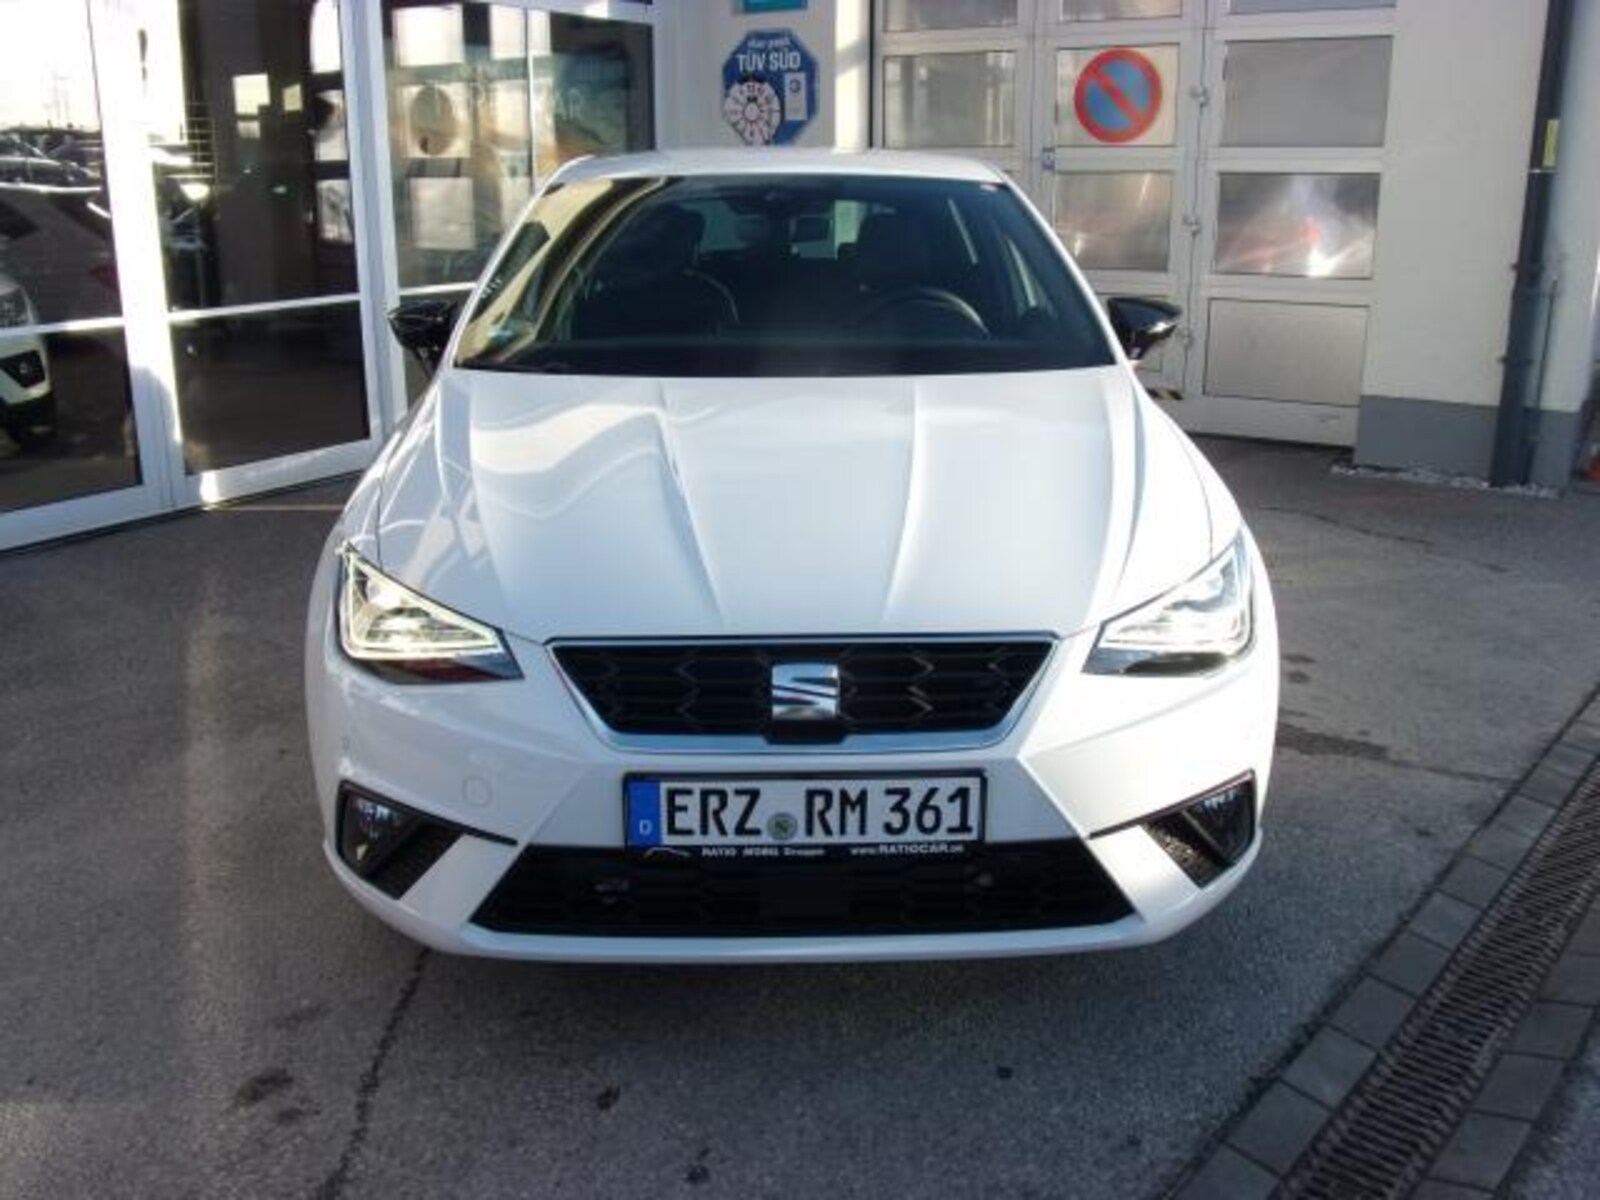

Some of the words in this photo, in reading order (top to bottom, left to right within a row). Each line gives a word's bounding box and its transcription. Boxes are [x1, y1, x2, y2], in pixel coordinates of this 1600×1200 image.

[737, 50, 766, 71] TÜV
[769, 48, 801, 71] SÜD
[666, 788, 762, 837] ERZ
[805, 787, 868, 837] RM
[883, 786, 973, 836] 361
[639, 819, 653, 836] D
